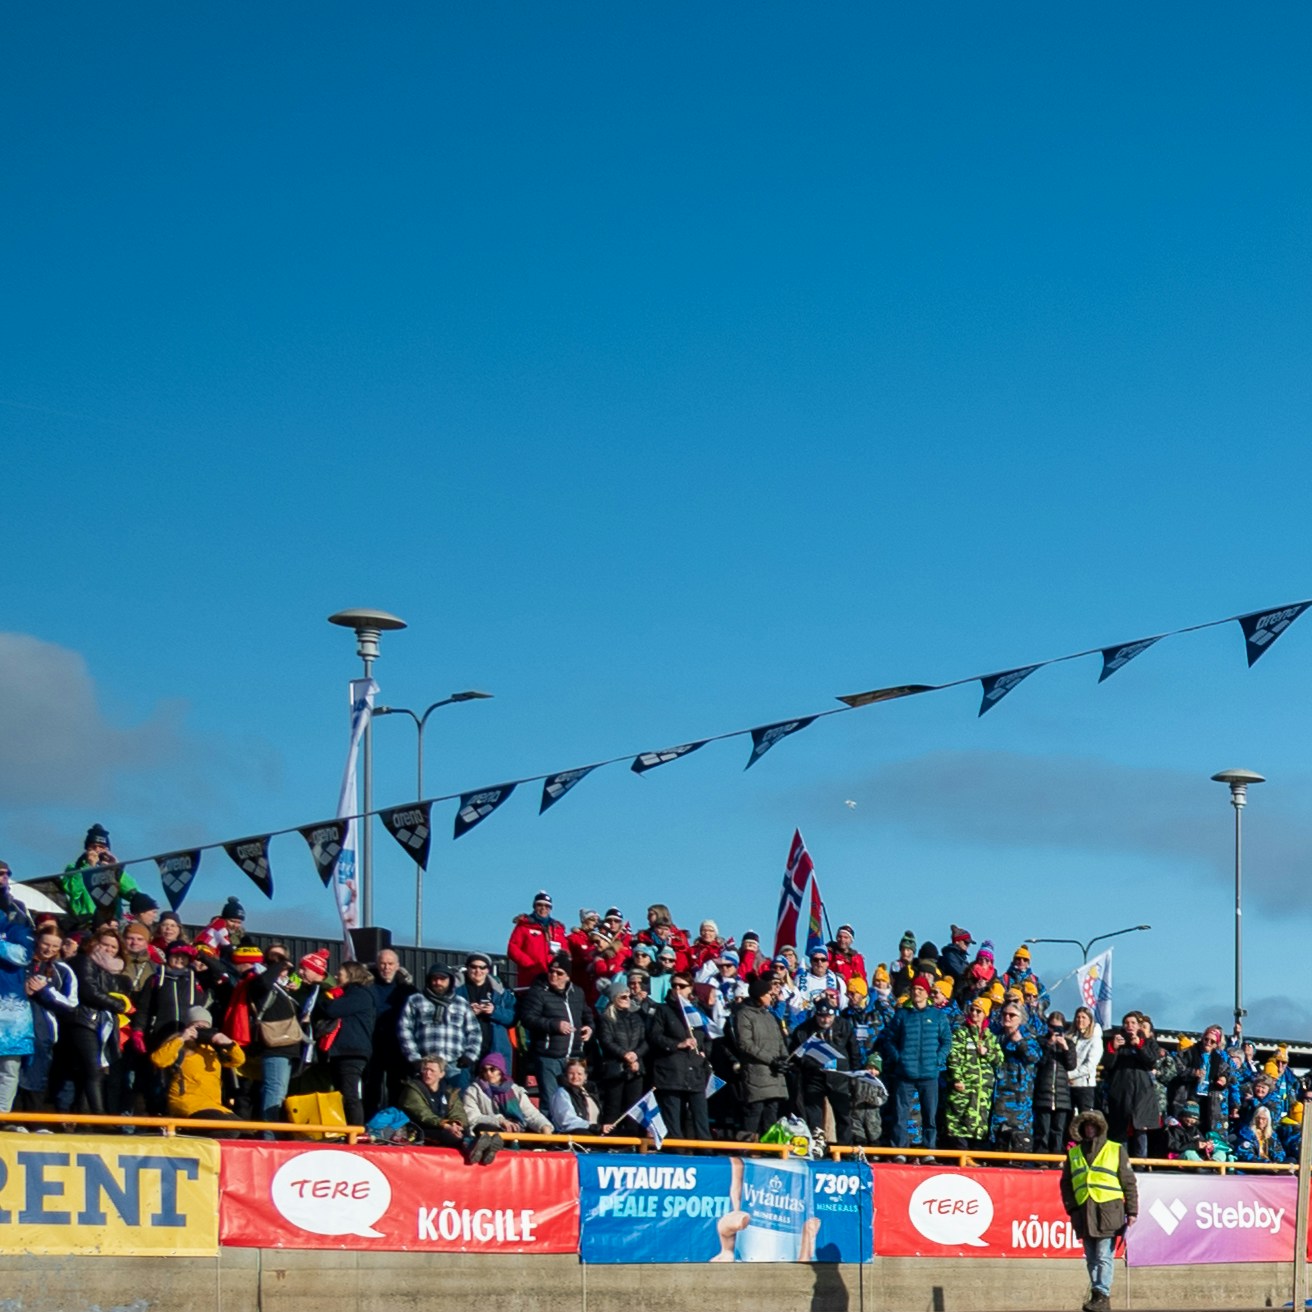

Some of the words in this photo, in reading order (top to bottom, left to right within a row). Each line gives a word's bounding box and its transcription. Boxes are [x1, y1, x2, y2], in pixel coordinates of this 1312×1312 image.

[1255, 604, 1303, 630] arena
[392, 808, 425, 828] arena
[0, 1151, 200, 1227] ENT
[290, 1179, 371, 1199] TERE
[597, 1166, 697, 1190] VYTAUTAS
[598, 1195, 657, 1218] PEALE
[743, 1182, 805, 1213] Vytautas
[816, 1203, 860, 1213] MINERALS
[922, 1198, 980, 1215] TERE
[418, 1201, 538, 1242] KÕIGILE
[1195, 1201, 1285, 1234] Stebby
[1011, 1214, 1084, 1249] KÕIGIL
